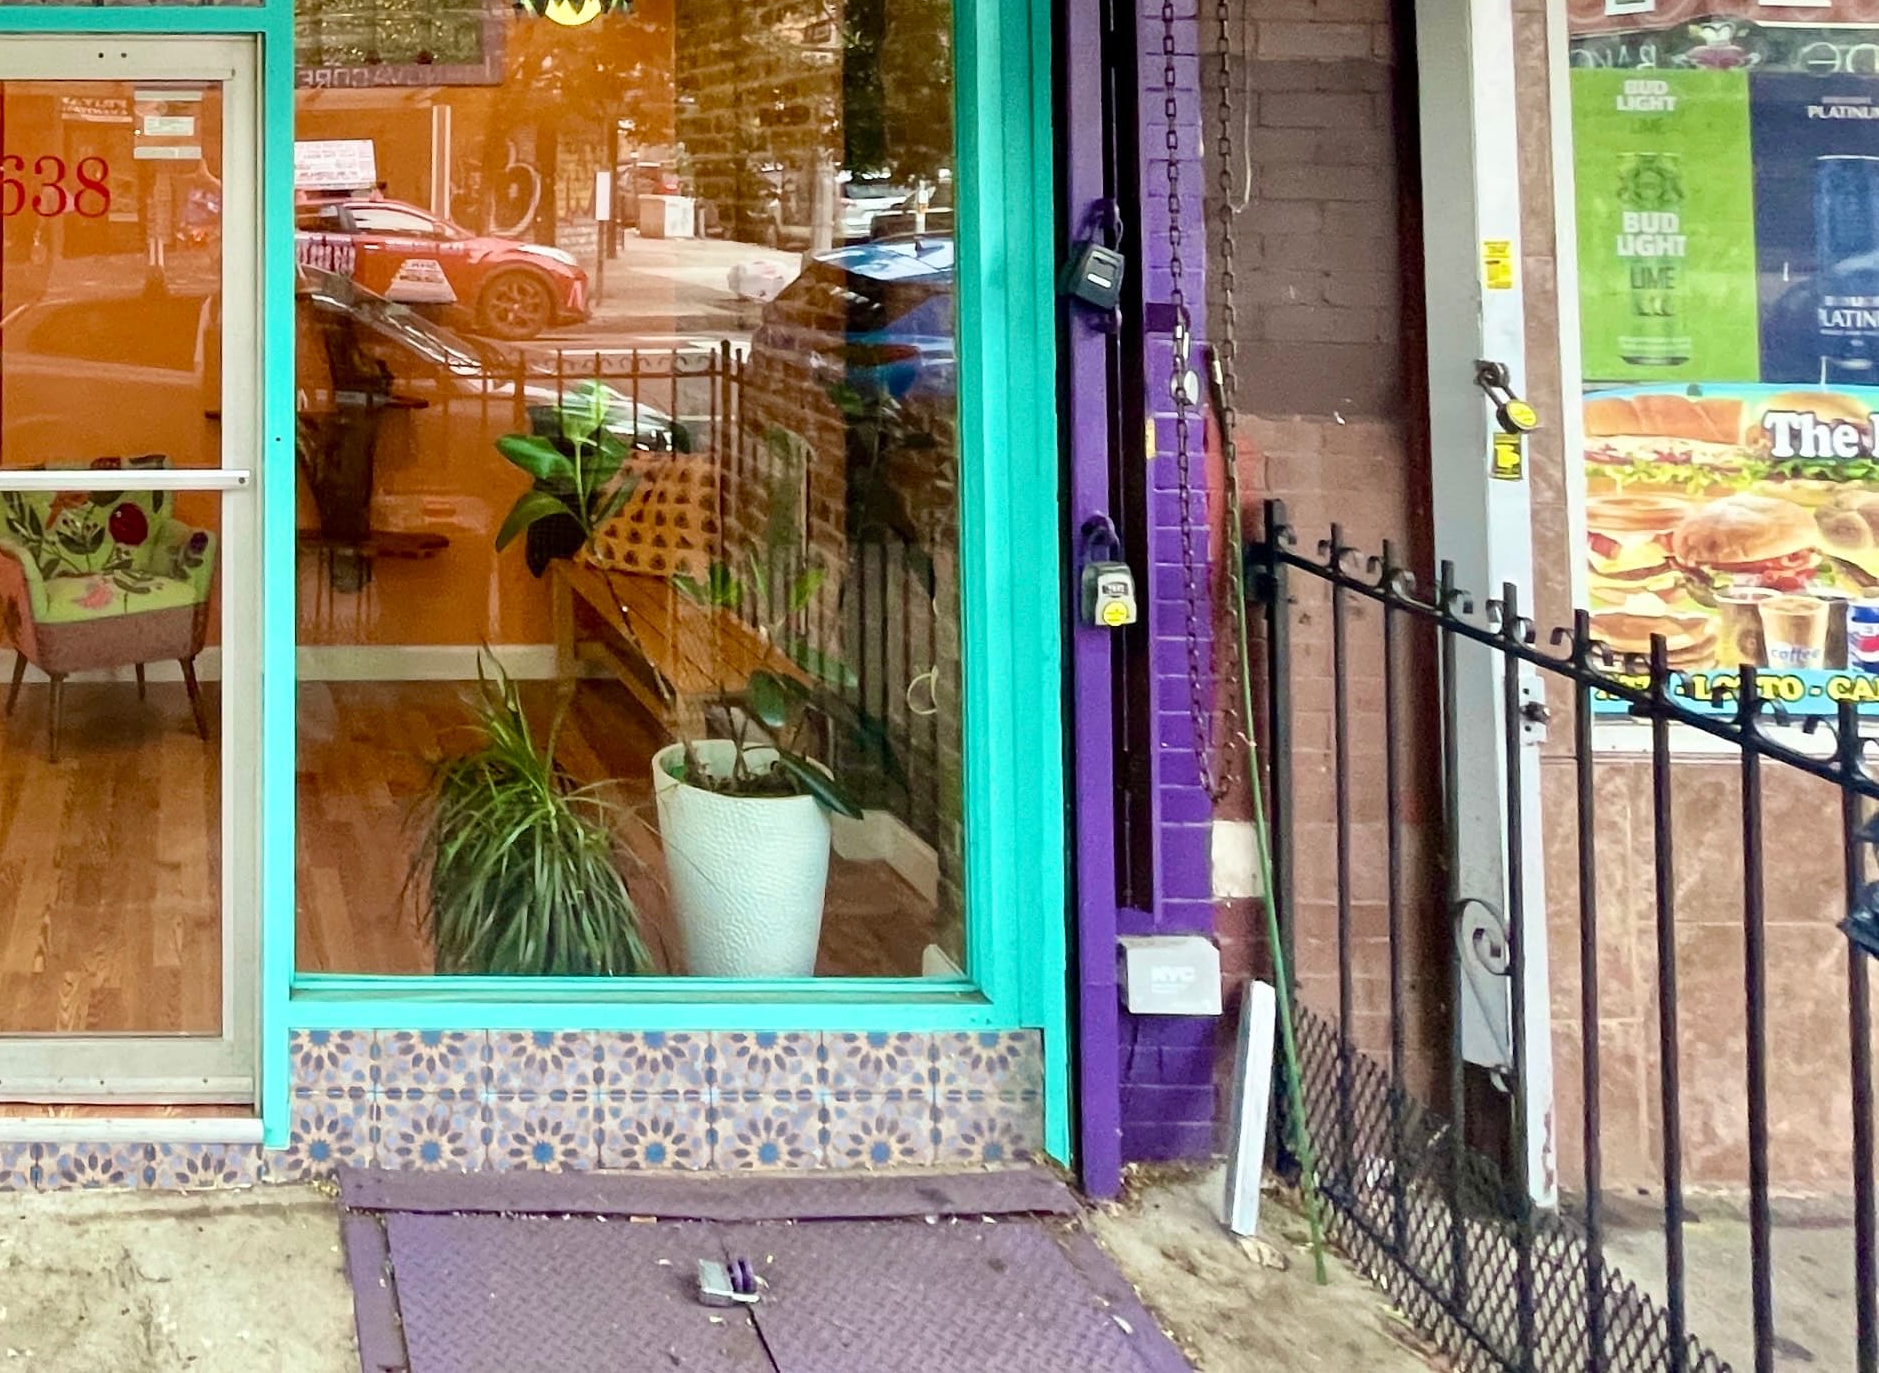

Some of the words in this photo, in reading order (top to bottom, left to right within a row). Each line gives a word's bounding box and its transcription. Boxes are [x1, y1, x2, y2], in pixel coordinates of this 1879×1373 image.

[1624, 80, 1668, 94] BUD
[1617, 96, 1677, 111] LIGHT
[1622, 211, 1679, 233] BUD
[1617, 234, 1686, 257] LIGHT
[1630, 266, 1675, 289] LIME
[1763, 411, 1860, 457] The
